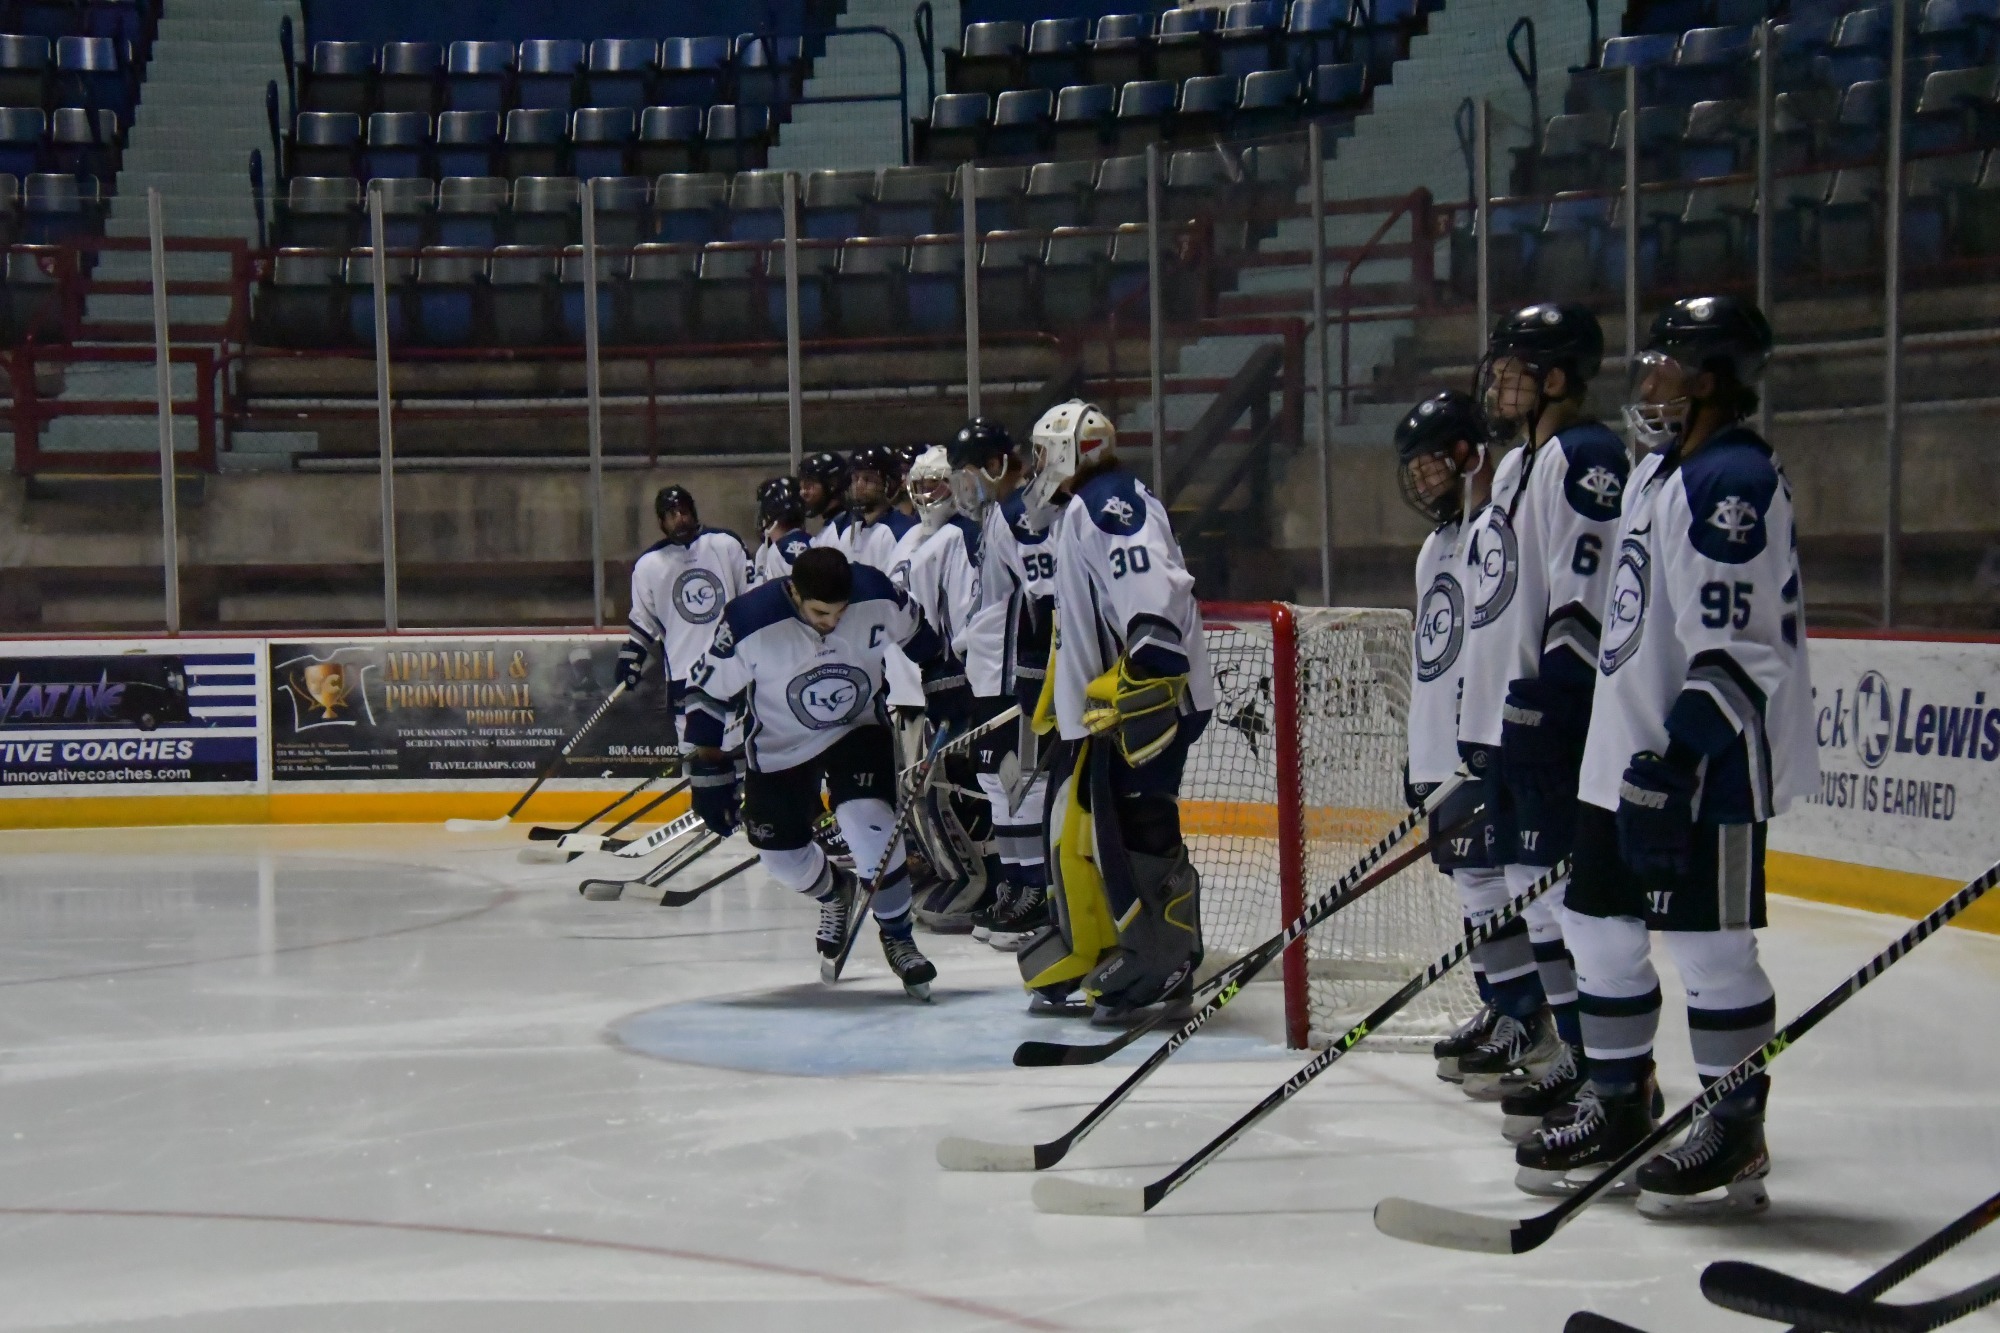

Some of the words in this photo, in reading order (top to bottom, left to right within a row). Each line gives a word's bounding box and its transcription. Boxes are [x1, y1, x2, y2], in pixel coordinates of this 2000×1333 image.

[1022, 553, 1054, 582] 59
[1109, 545, 1150, 580] 30
[1572, 533, 1602, 576] 6
[1700, 581, 1754, 630] 95
[869, 624, 885, 648] C
[385, 650, 496, 681] APPAREL
[509, 650, 528, 679] &
[385, 684, 533, 712] PROMOTIONAL
[809, 685, 854, 711] LVC
[466, 710, 535, 725] PRODUCTS
[1895, 688, 2000, 761] Lewis
[398, 729, 468, 737] TOURNAMENTS
[479, 728, 516, 736] HOTELS
[526, 727, 565, 735] APPAREL
[405, 739, 442, 747] SCREEN
[444, 739, 489, 747] PRINTING
[496, 738, 557, 747] EMBROIDERY
[62, 740, 194, 762] COACHES
[609, 745, 679, 756] 800.464.4002
[3, 767, 192, 783] innovativecoaches.com
[428, 761, 536, 770] TRAVELCHAMPS.COM
[1863, 775, 1878, 812] IS
[1883, 777, 1956, 821] EARNED
[1168, 1005, 1217, 1056] ALPHA
[1218, 979, 1241, 1006] LX
[1283, 1045, 1344, 1100] ALPHA
[1344, 1020, 1370, 1049] LX
[1691, 1060, 1767, 1123] ALPHA
